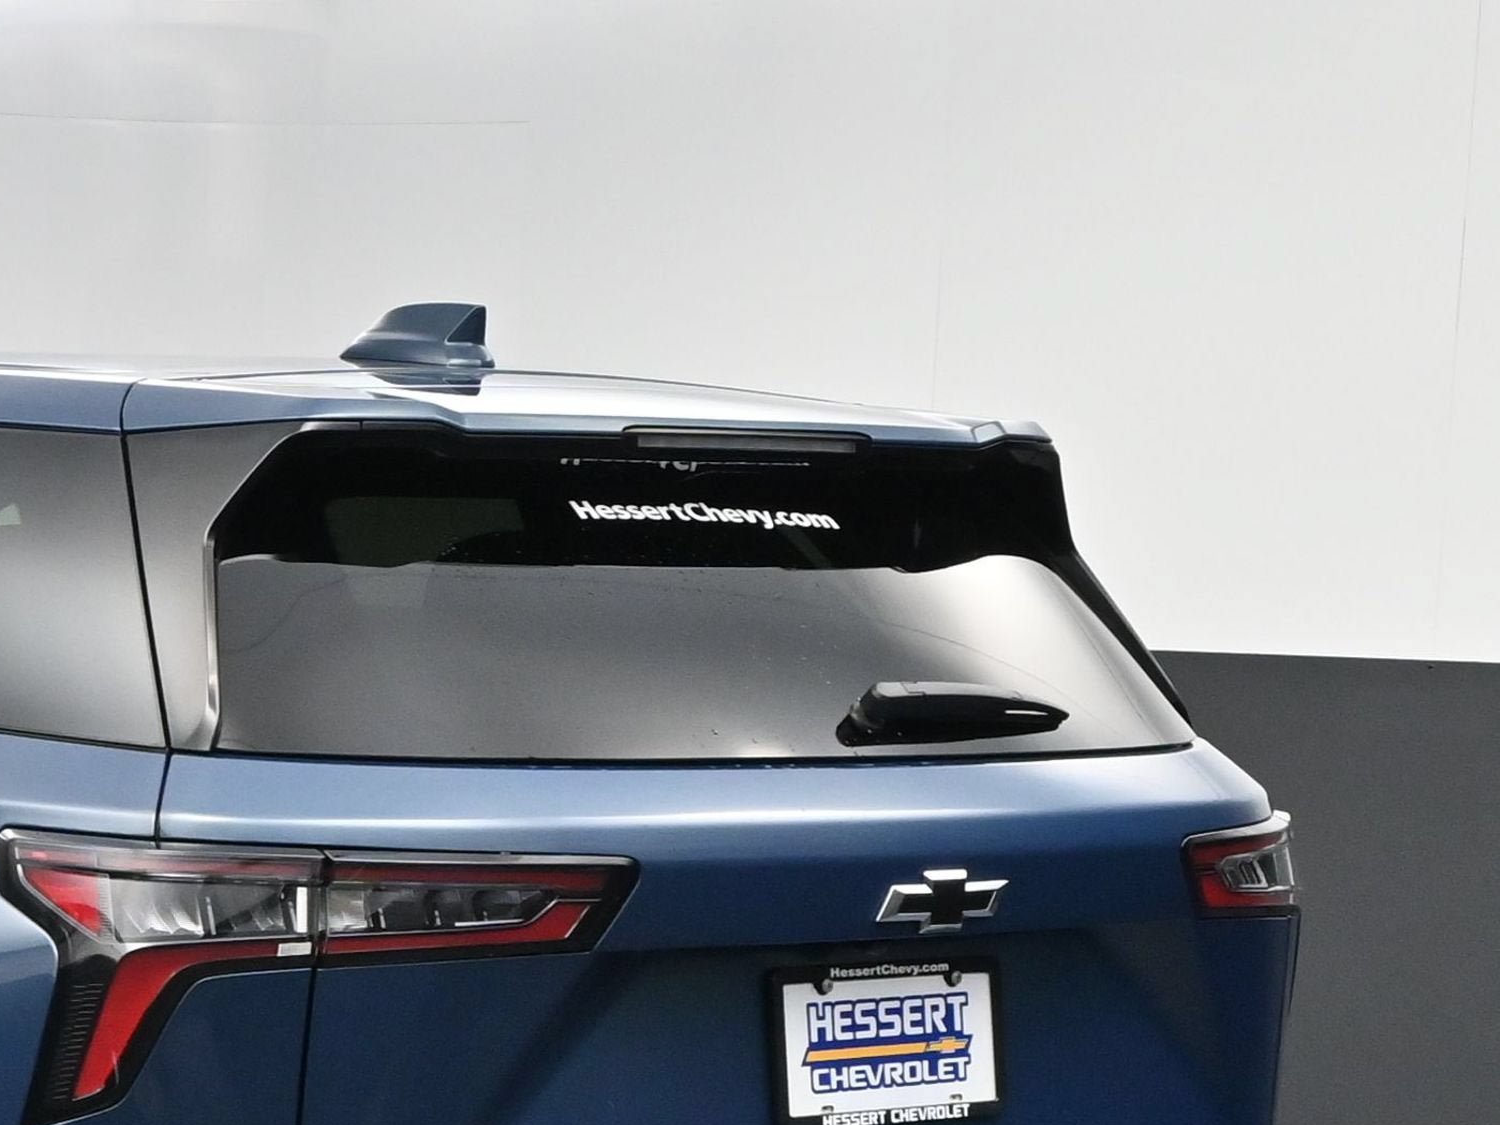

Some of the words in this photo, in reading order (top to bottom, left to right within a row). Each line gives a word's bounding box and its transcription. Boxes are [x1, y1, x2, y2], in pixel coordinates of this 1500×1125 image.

[568, 500, 840, 530] HessertChevy.com
[829, 962, 950, 978] HessertChevy.com
[806, 992, 969, 1044] HESSERT
[810, 1056, 971, 1095] CHEVROLET
[890, 1104, 971, 1123] CHEVROLET
